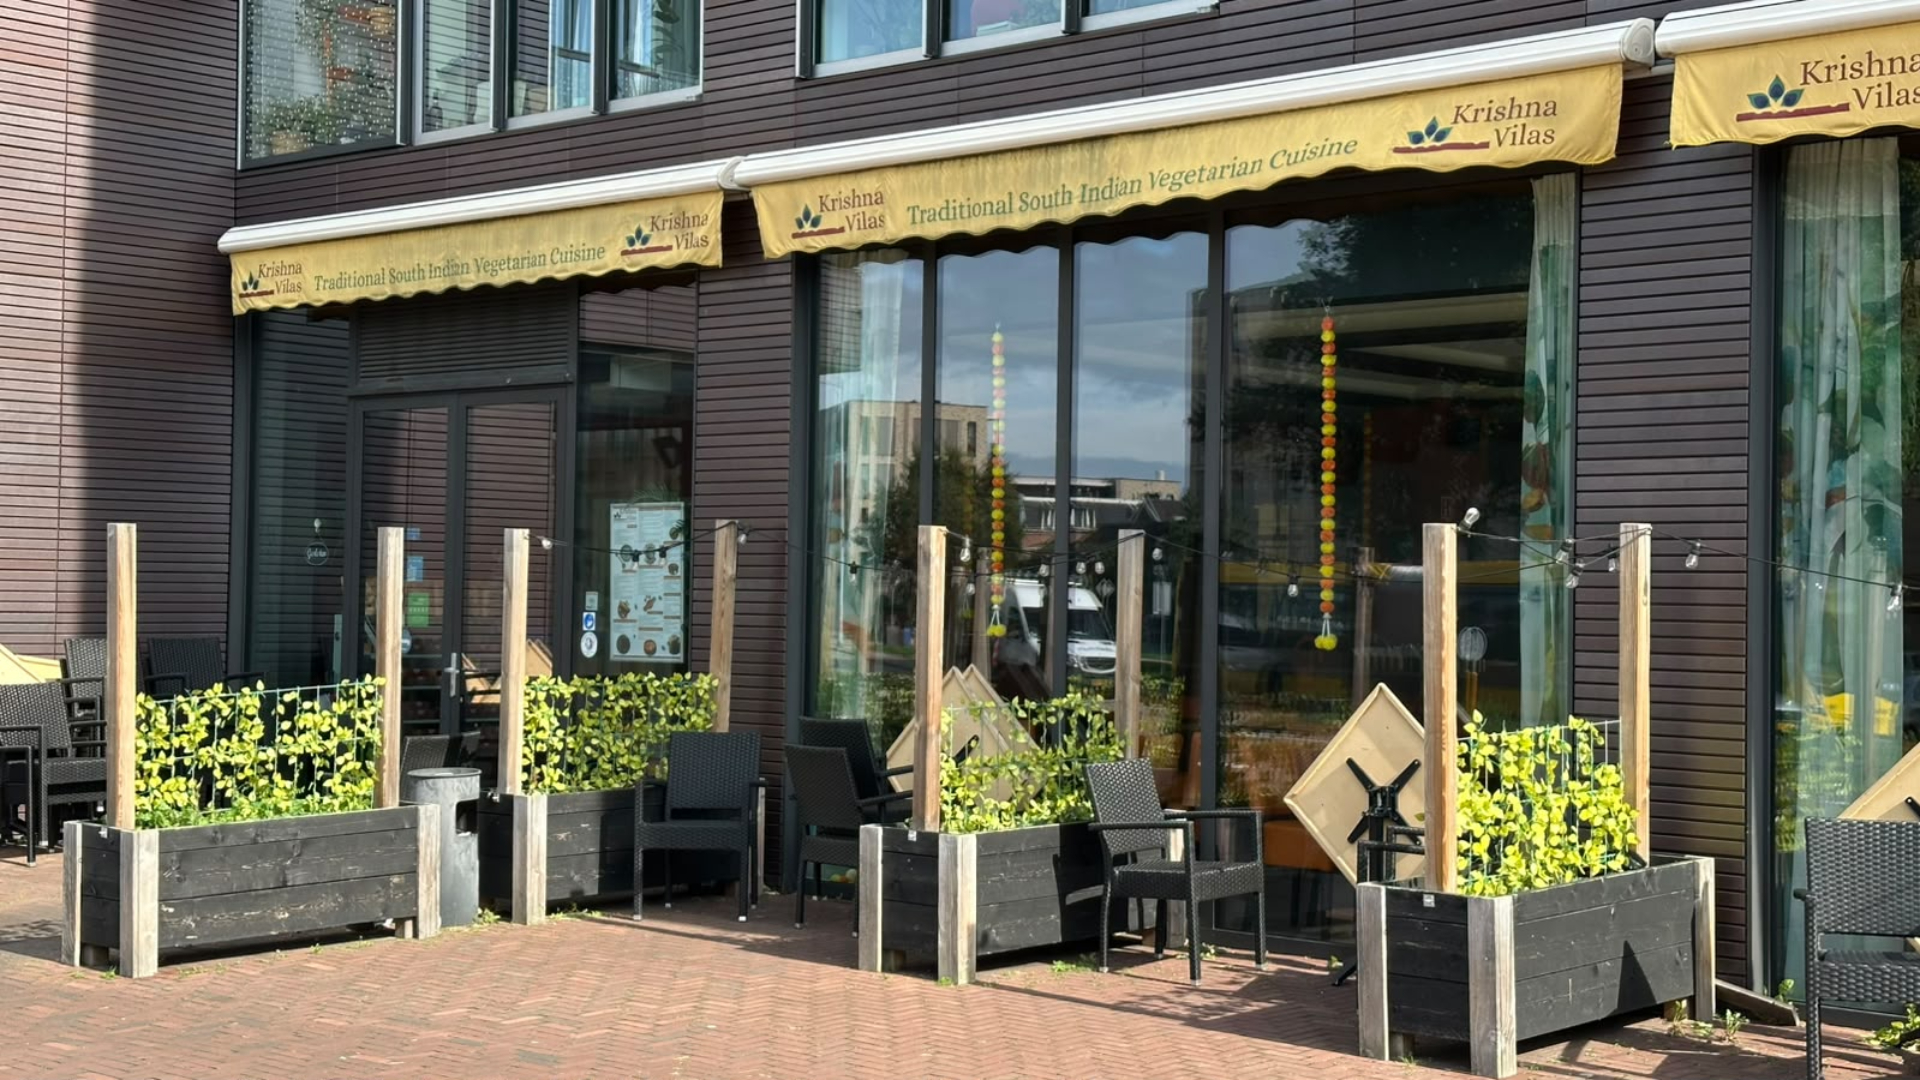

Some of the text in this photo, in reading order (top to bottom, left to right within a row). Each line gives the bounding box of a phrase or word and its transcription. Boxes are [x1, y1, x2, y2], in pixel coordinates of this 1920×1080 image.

[1800, 50, 1920, 86] Krishna
[1451, 97, 1557, 125] Krishna
[1494, 123, 1555, 147] Vilas
[907, 137, 1358, 226] Traditional South Indian Vegetarian Cuisine
[818, 188, 884, 213] Krishna
[650, 211, 708, 232] Krishna
[845, 211, 885, 232] Vilas
[674, 232, 709, 250] Vilas
[258, 260, 302, 279] Krishna
[314, 243, 606, 291] Traditional South Indian Vegetarian Cuisine
[274, 278, 302, 294] Vilas
